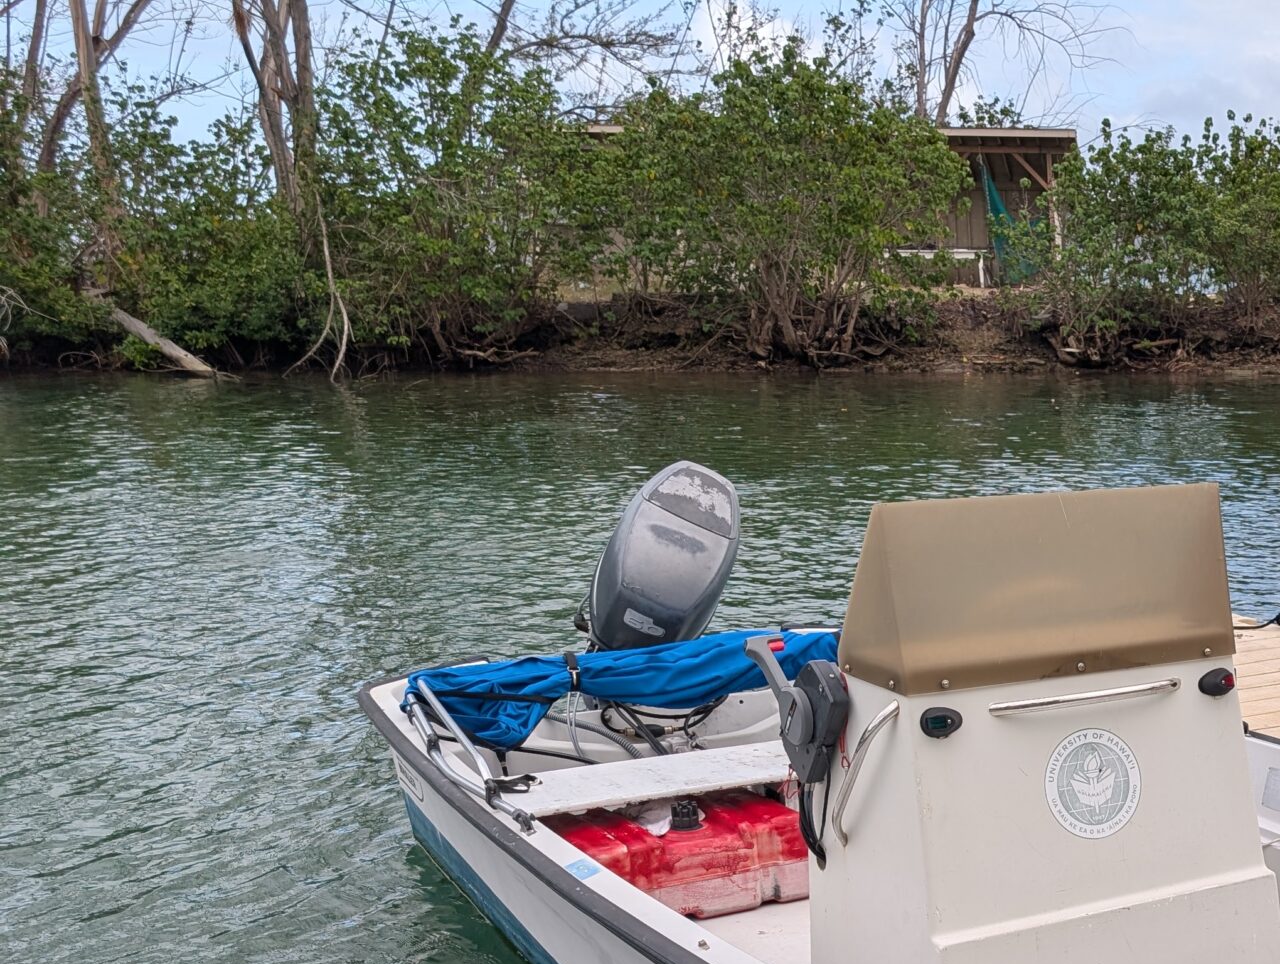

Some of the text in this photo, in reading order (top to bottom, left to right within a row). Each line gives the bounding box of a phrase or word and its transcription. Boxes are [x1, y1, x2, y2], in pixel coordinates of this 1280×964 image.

[1048, 732, 1089, 783] UNIVERSITY
[1092, 732, 1105, 740] OF
[1130, 784, 1138, 804] PONO
